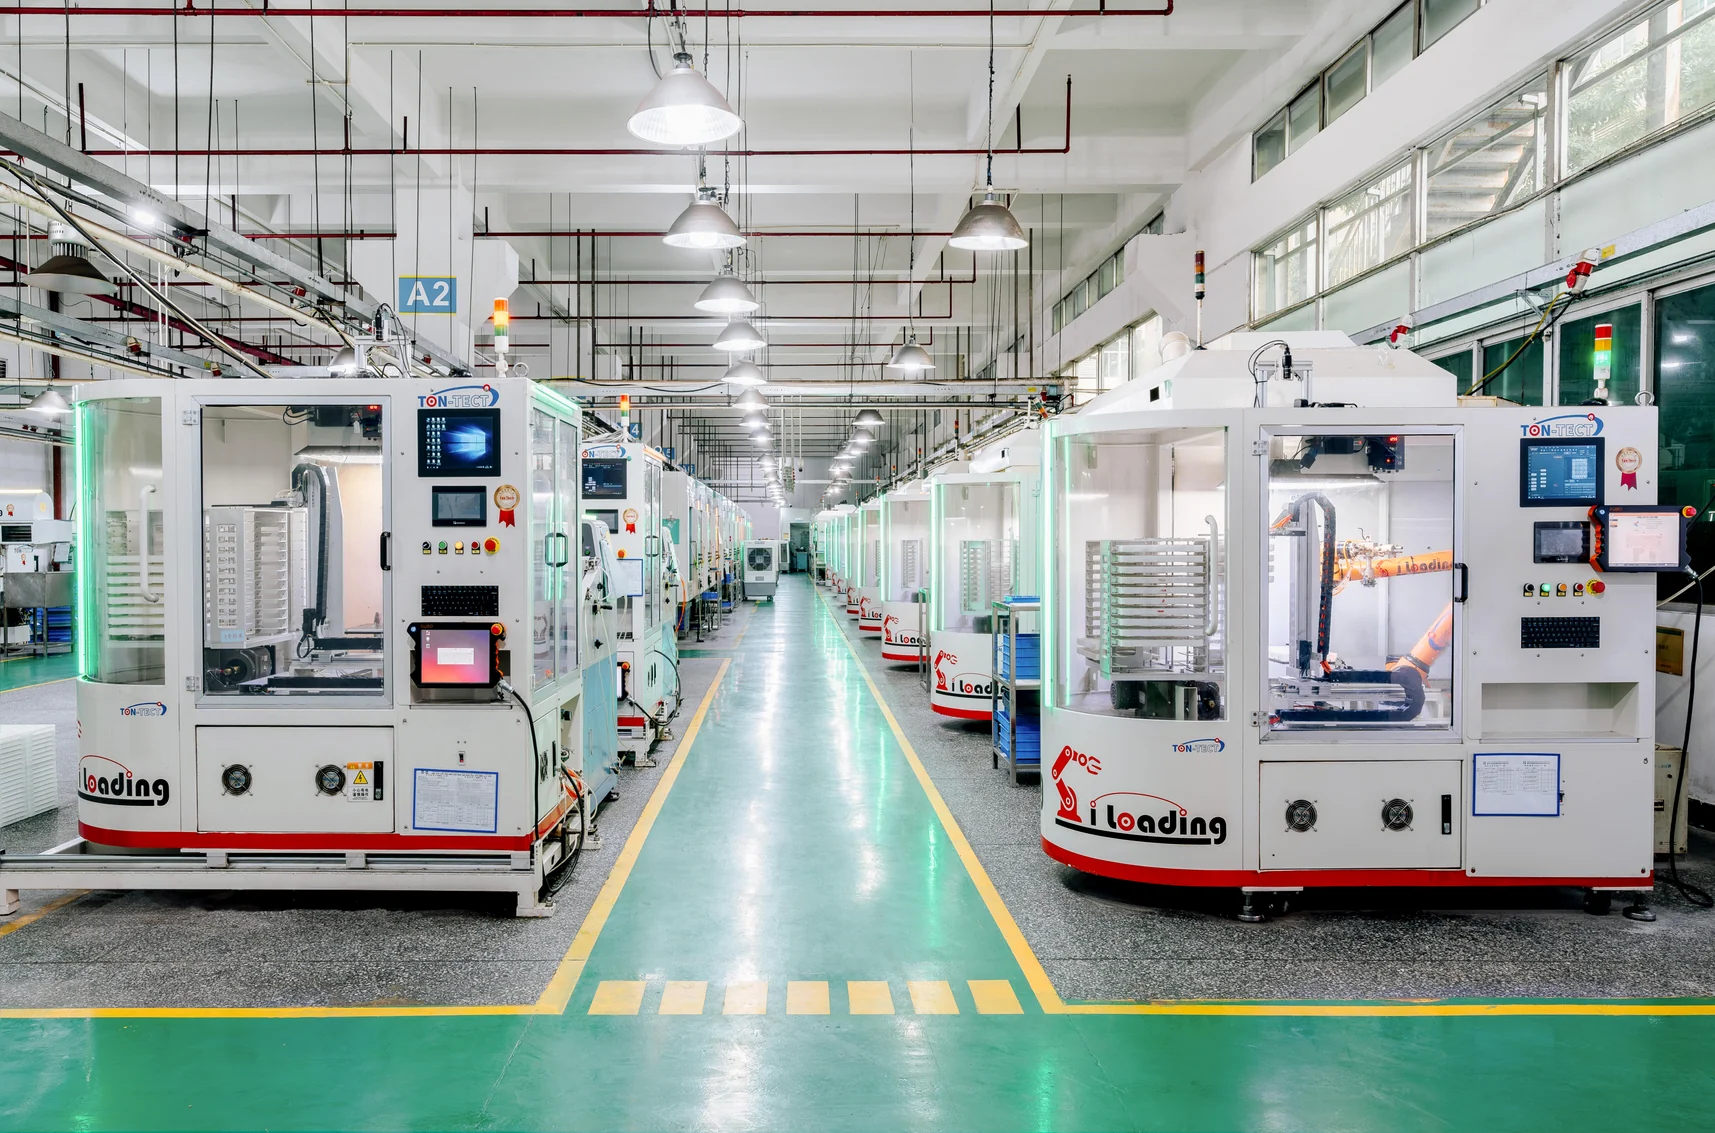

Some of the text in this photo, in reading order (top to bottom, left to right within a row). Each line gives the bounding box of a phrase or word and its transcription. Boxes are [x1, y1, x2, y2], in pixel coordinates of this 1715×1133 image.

[406, 280, 450, 306] A2
[417, 394, 490, 408] TON-TECT
[1520, 423, 1594, 437] TON-TECT
